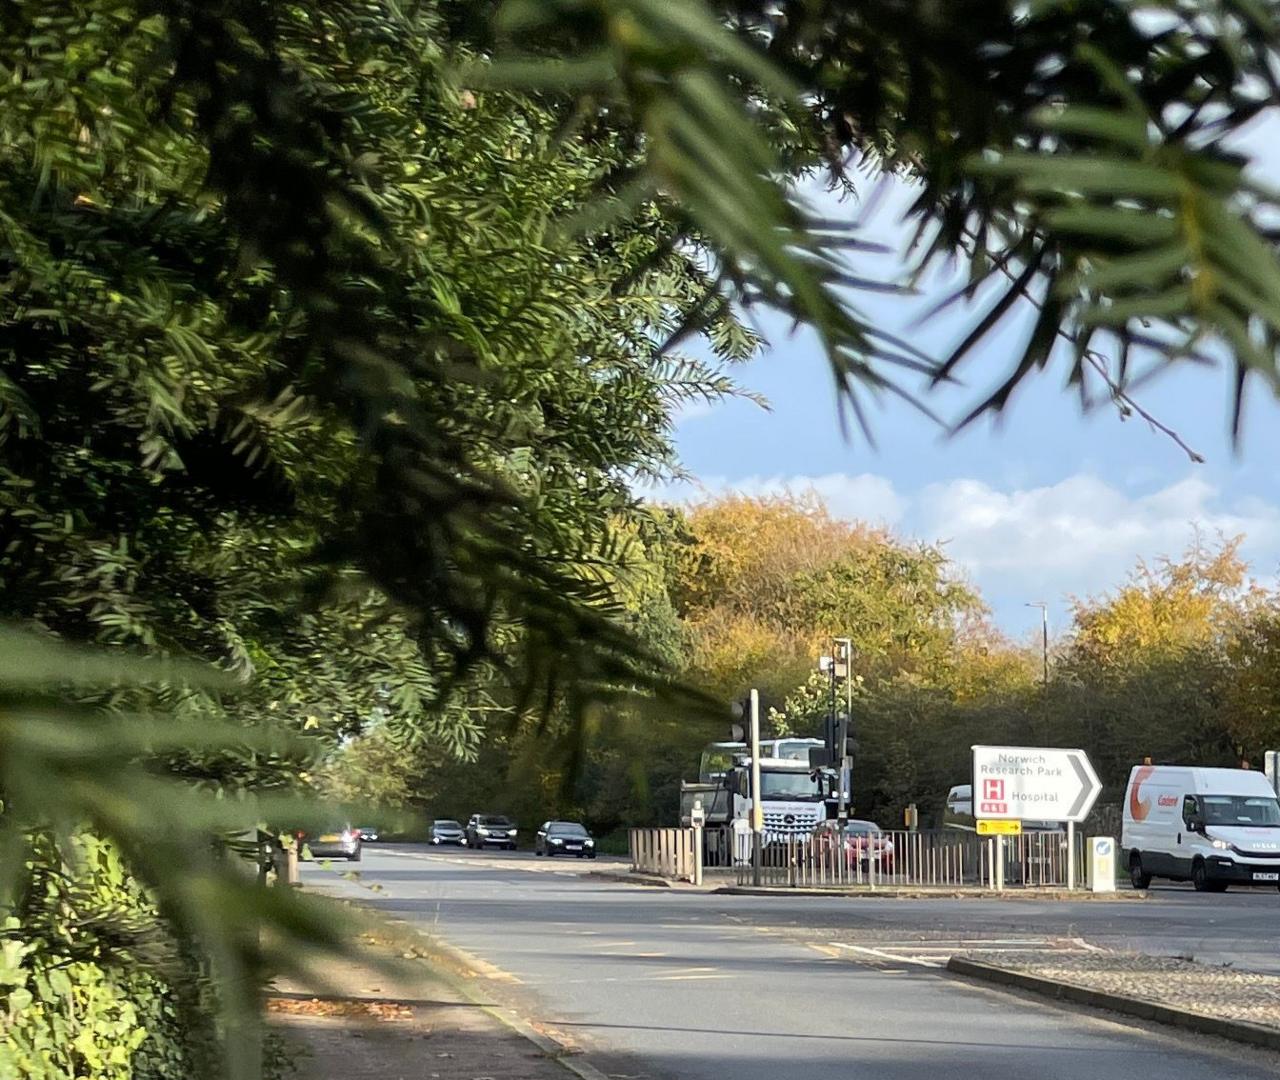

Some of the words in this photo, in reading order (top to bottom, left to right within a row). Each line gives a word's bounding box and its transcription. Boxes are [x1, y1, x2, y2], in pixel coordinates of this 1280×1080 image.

[998, 753, 1045, 764] Norwich
[980, 764, 1033, 775] Research
[1037, 766, 1062, 777] Park
[1012, 791, 1059, 803] Hospital
